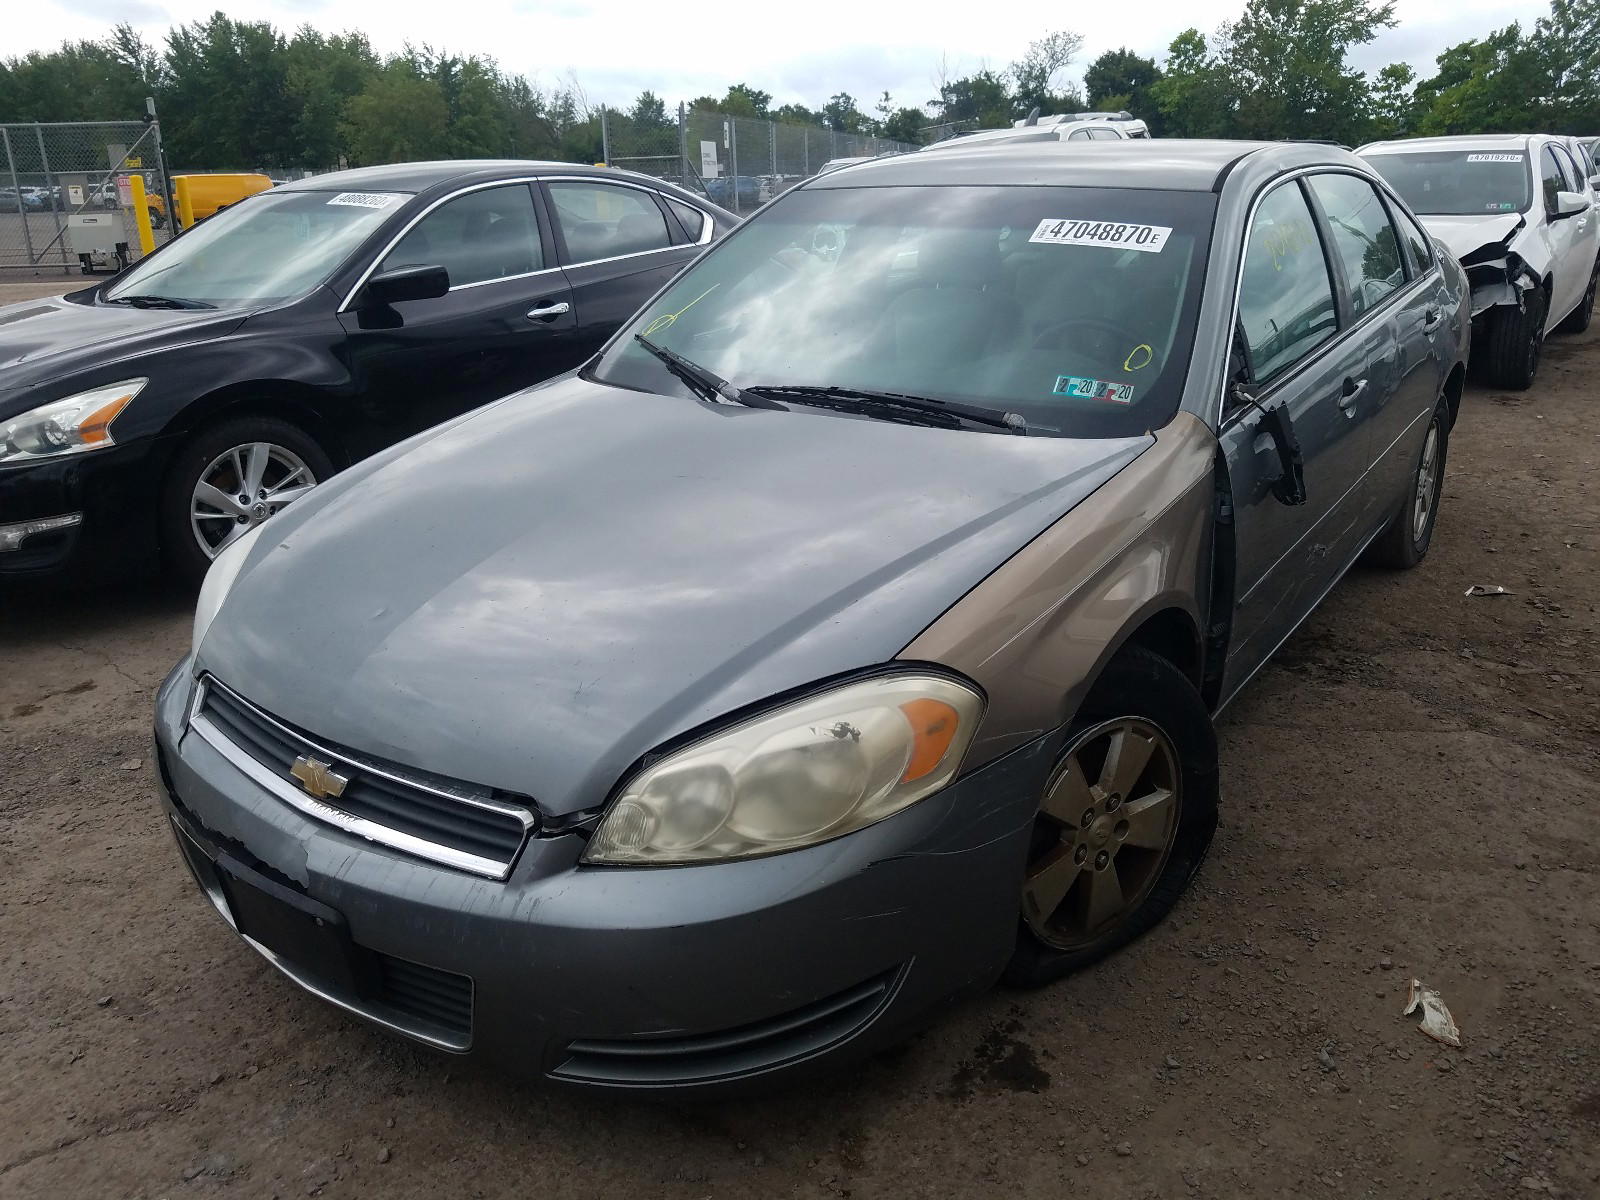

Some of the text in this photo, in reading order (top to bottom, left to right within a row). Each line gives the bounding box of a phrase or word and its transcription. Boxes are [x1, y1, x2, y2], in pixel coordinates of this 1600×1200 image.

[119, 178, 131, 186] STO
[1060, 378, 1093, 393] 2 20
[1098, 382, 1131, 399] 2 20
